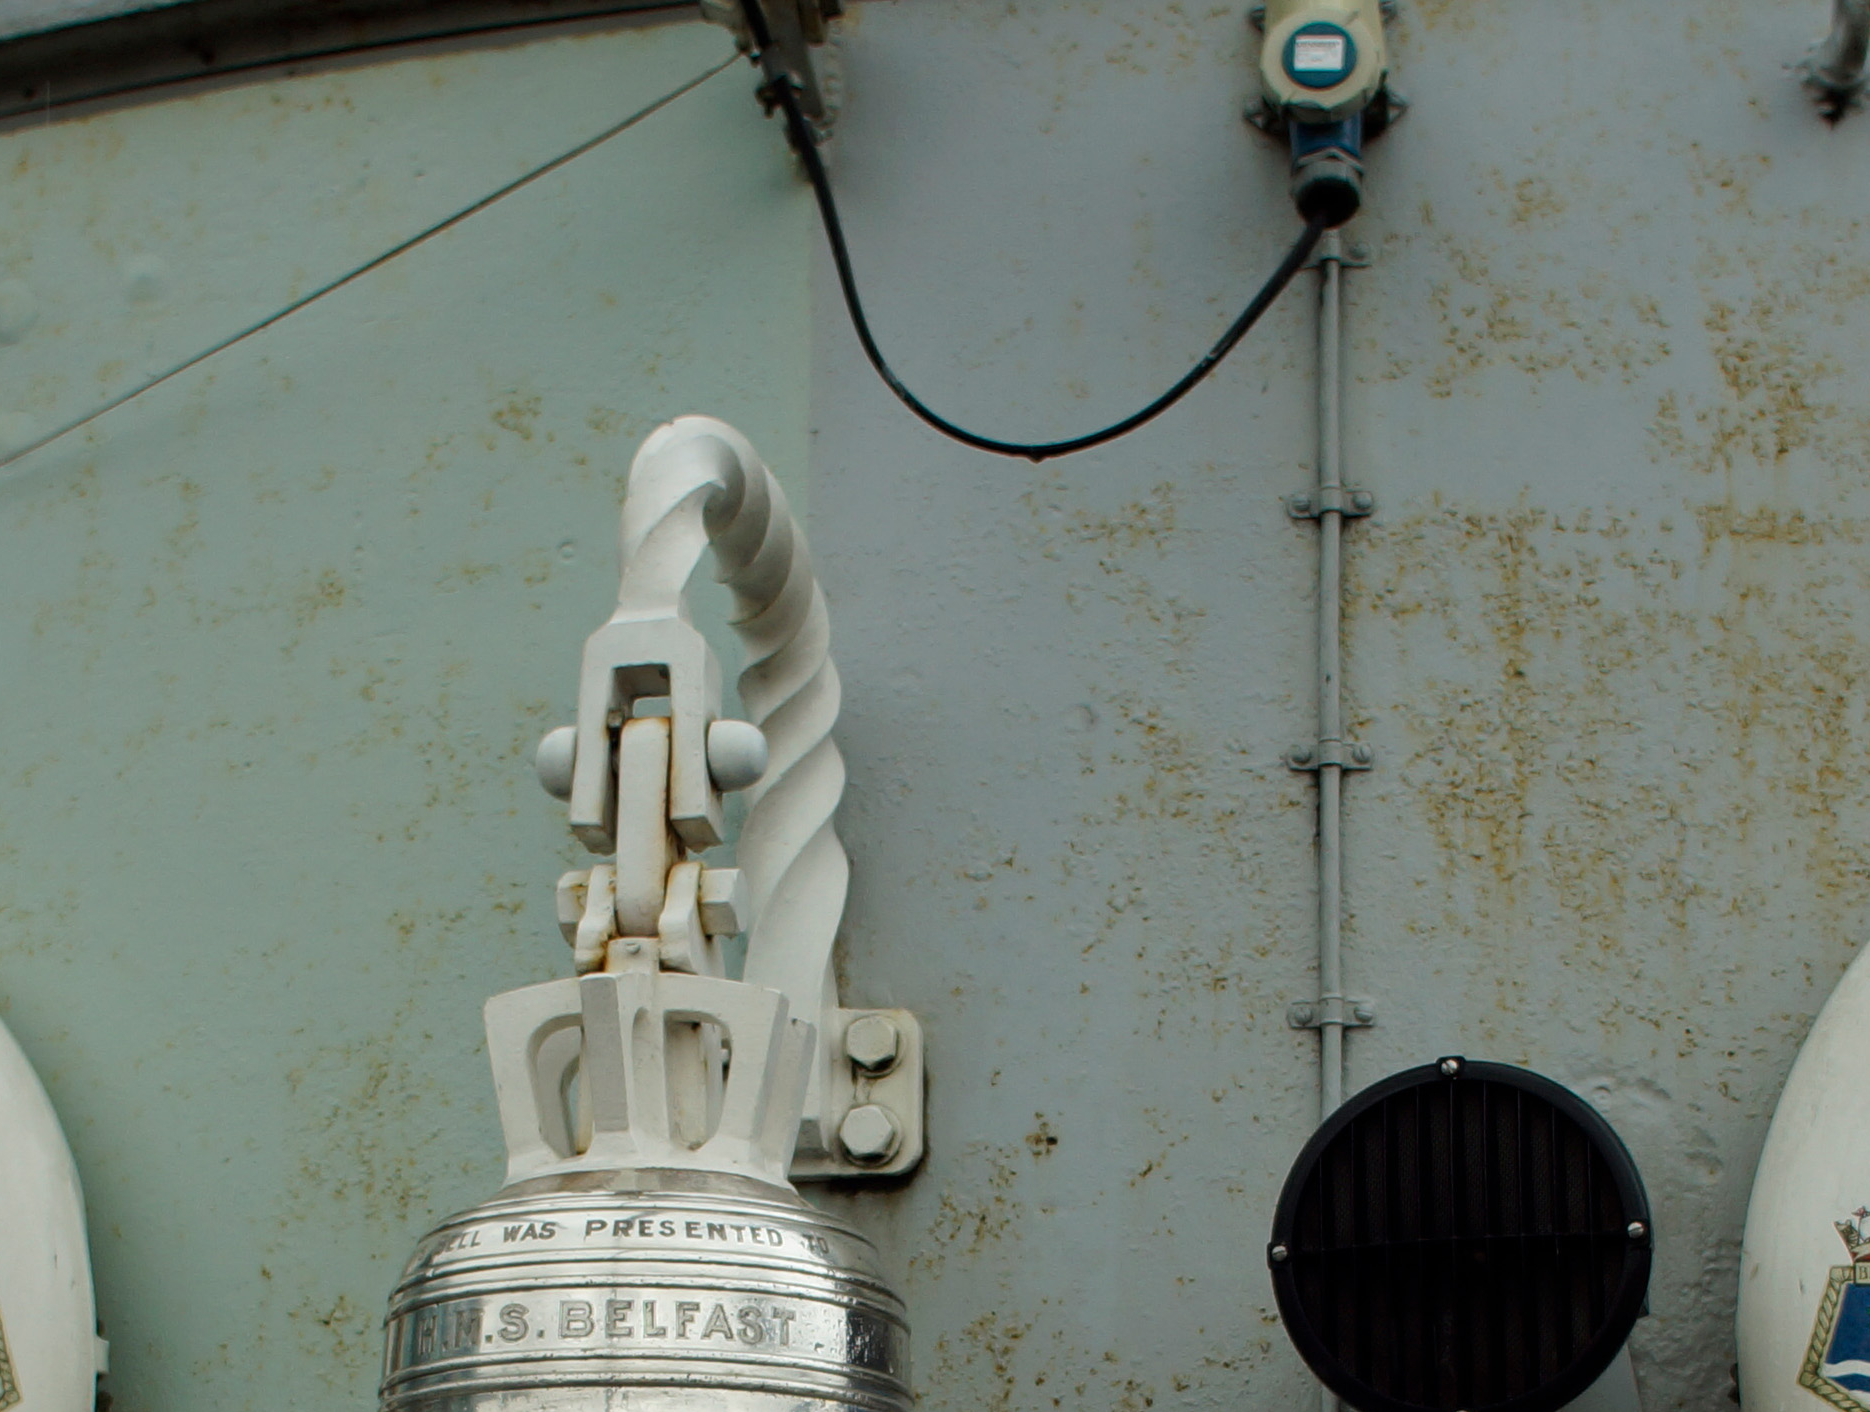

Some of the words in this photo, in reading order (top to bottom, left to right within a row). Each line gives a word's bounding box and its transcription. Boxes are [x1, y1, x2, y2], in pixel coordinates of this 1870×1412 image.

[503, 1222, 556, 1243] WAS
[585, 1218, 784, 1248] PRESENTED
[803, 1233, 829, 1254] TO
[559, 1298, 797, 1347] BELFAST
